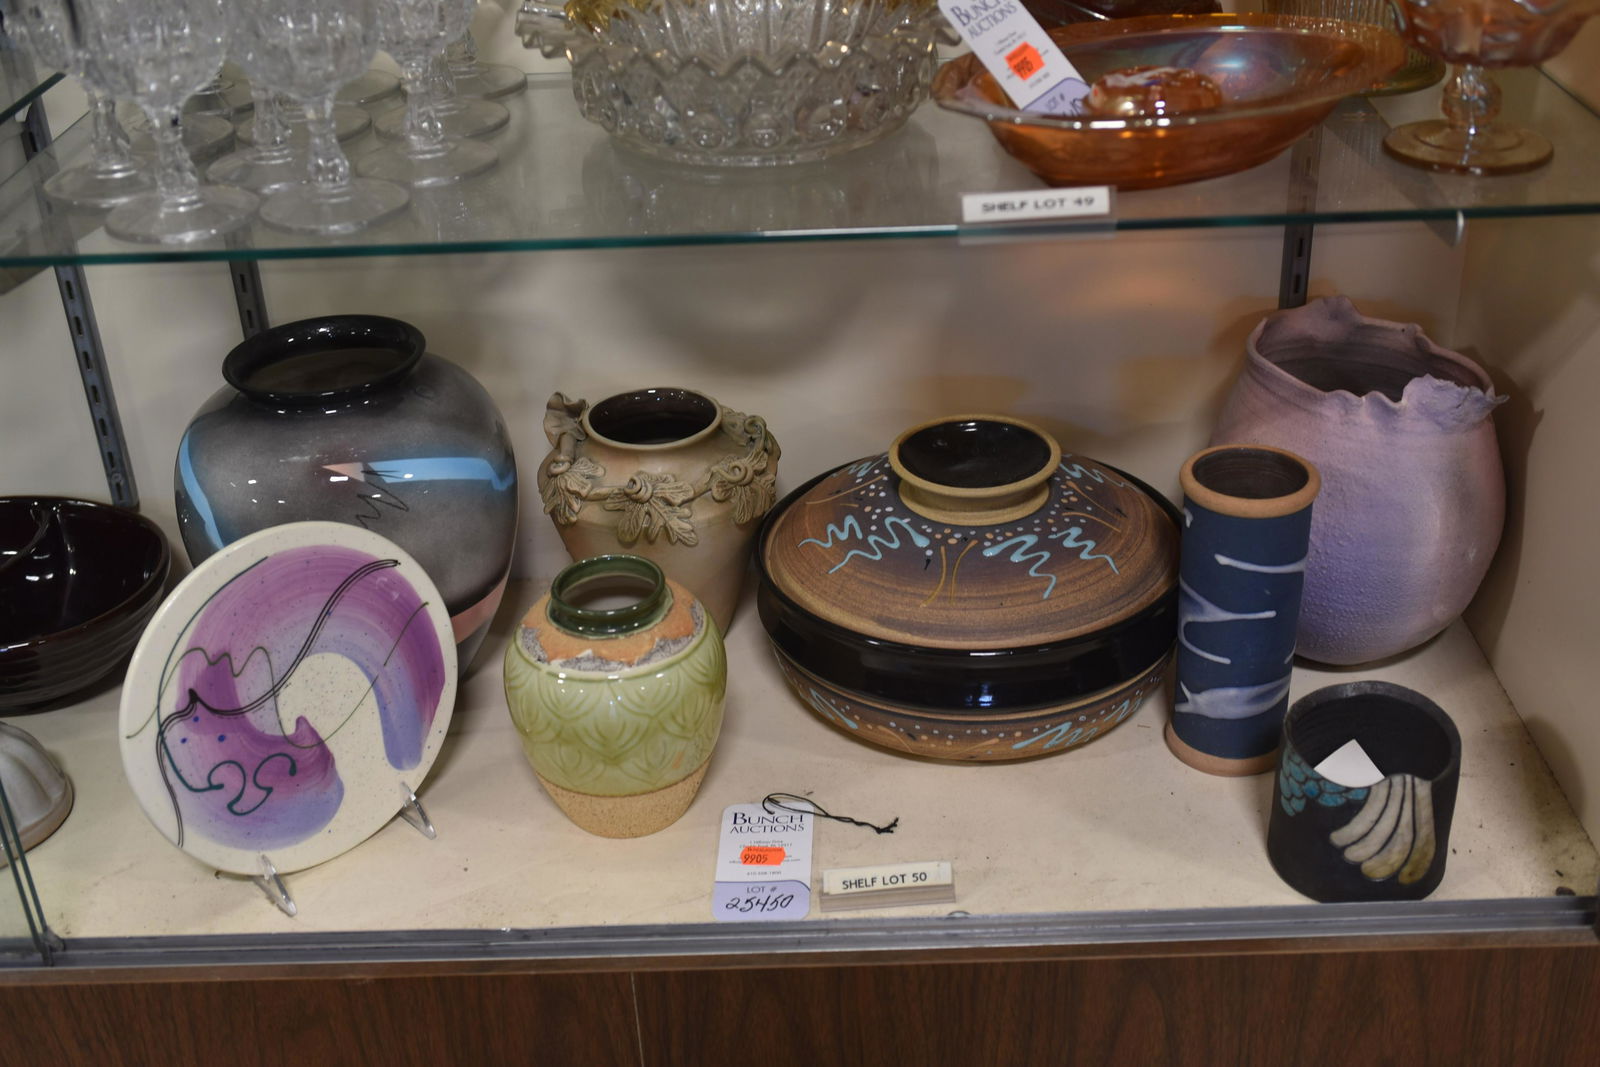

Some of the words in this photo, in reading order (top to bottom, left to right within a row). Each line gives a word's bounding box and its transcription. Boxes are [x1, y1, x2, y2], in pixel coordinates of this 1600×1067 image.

[949, 0, 1001, 27] BUNC
[968, 2, 1018, 38] AUCTIONS
[981, 201, 1028, 214] SHELF
[1034, 198, 1066, 210] LOT
[1073, 196, 1095, 206] 49
[733, 812, 803, 826] BUNCH
[730, 823, 805, 834] AUCTIONS
[743, 854, 768, 865] 9905
[842, 877, 878, 890] SHELF
[882, 874, 907, 886] LOT
[912, 872, 928, 883] 50
[726, 894, 794, 912] 25450
